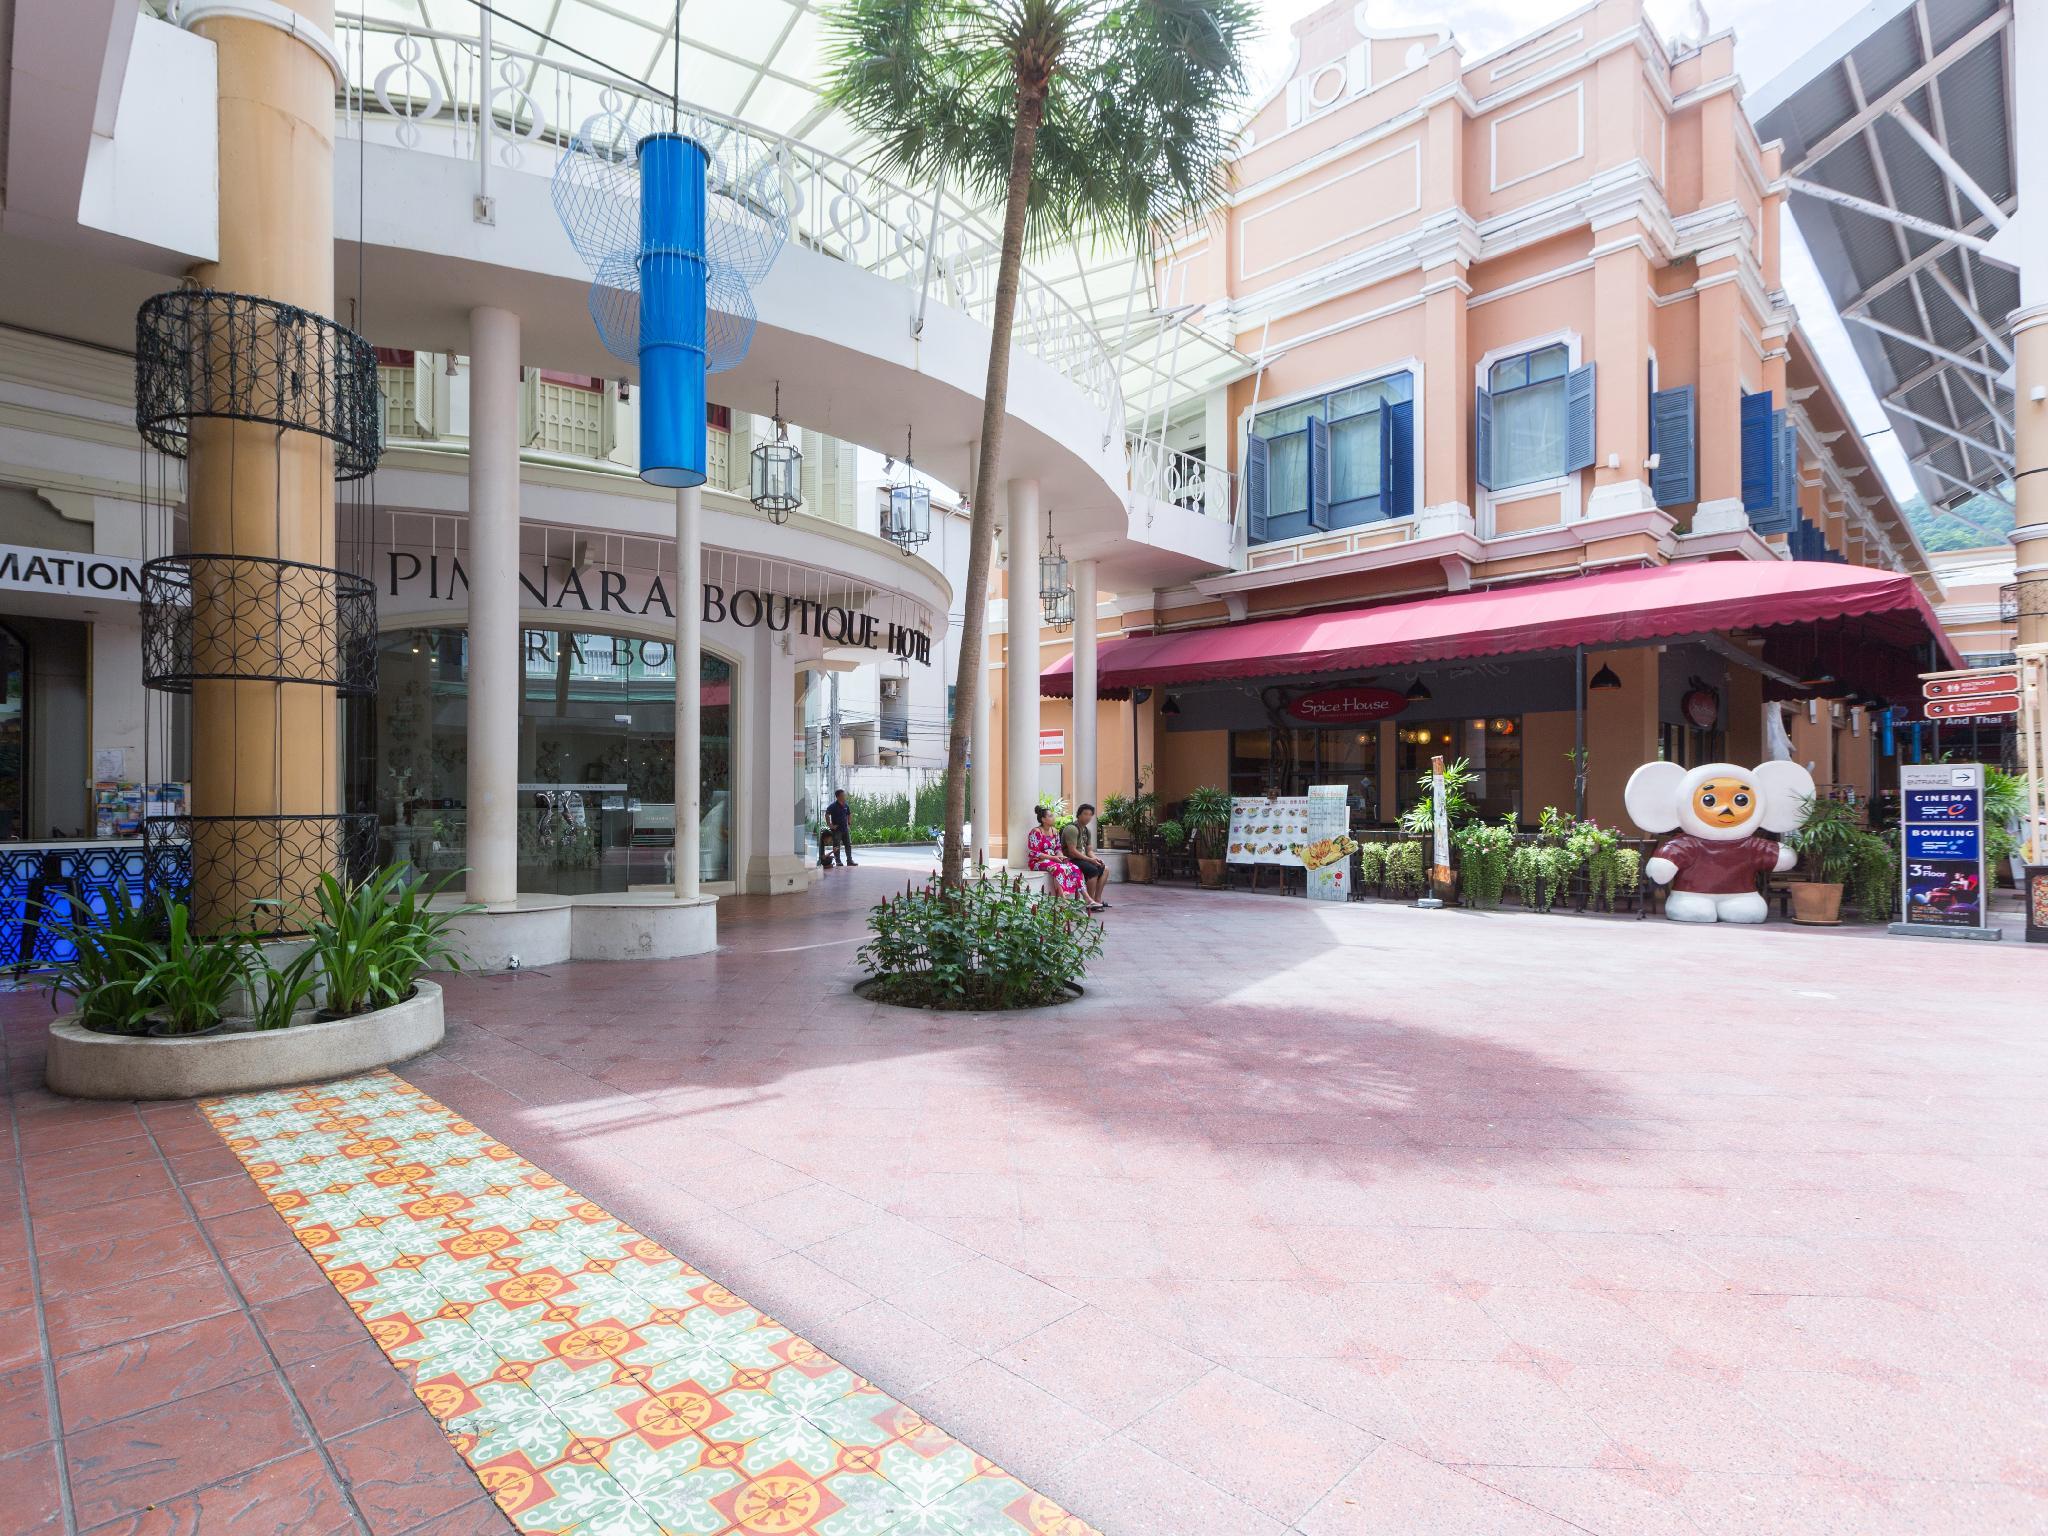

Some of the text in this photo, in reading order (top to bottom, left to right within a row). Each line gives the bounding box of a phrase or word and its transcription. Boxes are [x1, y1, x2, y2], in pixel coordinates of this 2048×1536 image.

[701, 584, 880, 650] BOUTIQUE
[1300, 697, 1390, 717] Spice House
[1945, 716, 1970, 725] And
[1976, 715, 2002, 725] Thai
[1909, 864, 1923, 877] 3
